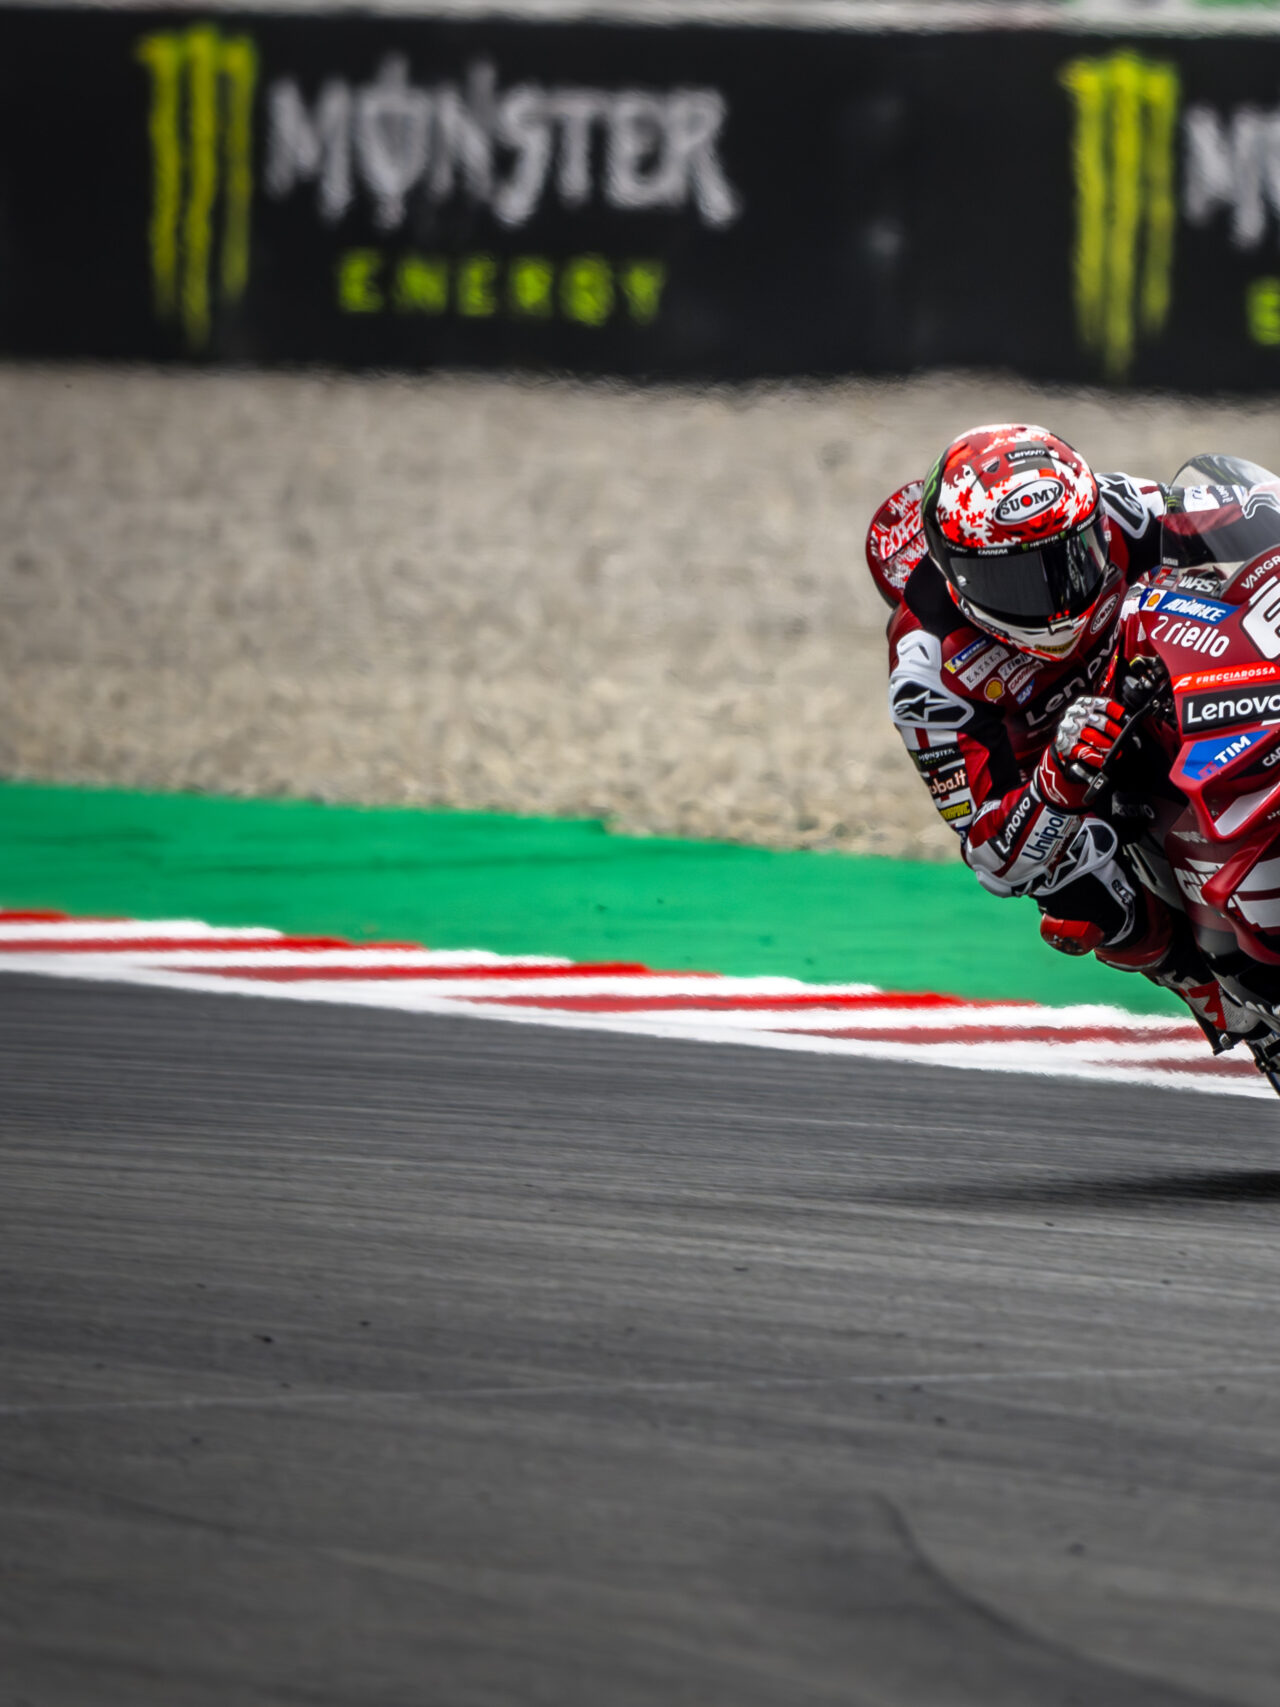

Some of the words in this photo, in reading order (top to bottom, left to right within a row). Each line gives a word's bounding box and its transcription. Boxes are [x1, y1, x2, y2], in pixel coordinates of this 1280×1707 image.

[266, 54, 740, 229] MONSTER
[339, 250, 664, 325] ENERGY
[1000, 486, 1058, 516] SUOMY
[1178, 575, 1218, 593] WRS
[1162, 598, 1226, 622] ADVANCE
[1162, 620, 1230, 657] riello
[1196, 667, 1276, 684] FRECCIAROSSA
[1214, 735, 1252, 764] TIM
